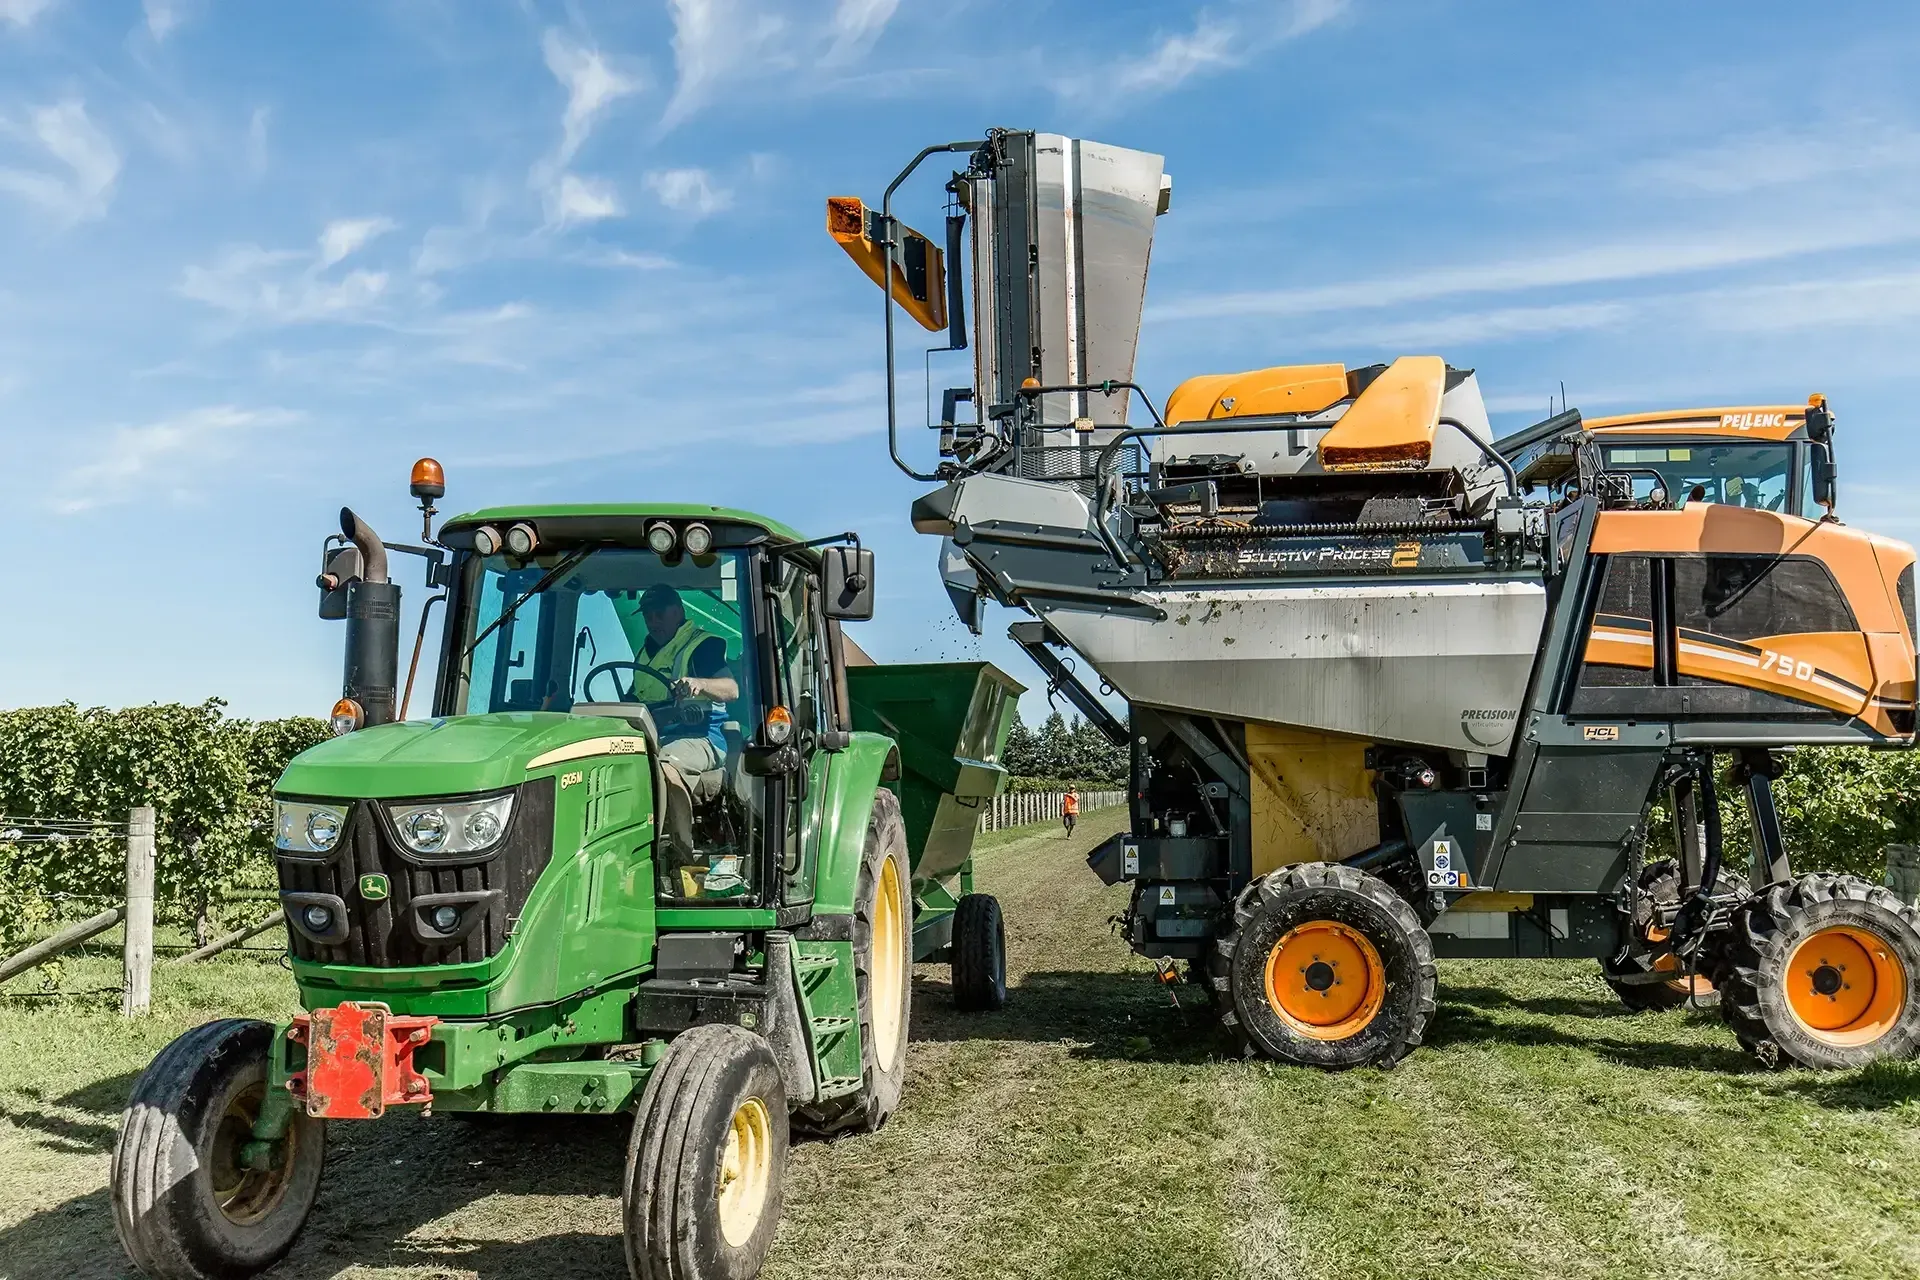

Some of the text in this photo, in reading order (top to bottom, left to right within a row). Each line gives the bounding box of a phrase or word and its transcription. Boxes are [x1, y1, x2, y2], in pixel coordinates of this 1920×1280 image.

[1721, 412, 1783, 431] PELLENC
[1319, 547, 1392, 561] PROCESS
[1391, 541, 1421, 568] 2
[1761, 649, 1812, 681] 750
[1460, 709, 1517, 720] PRECISION
[1585, 727, 1616, 736] HCL
